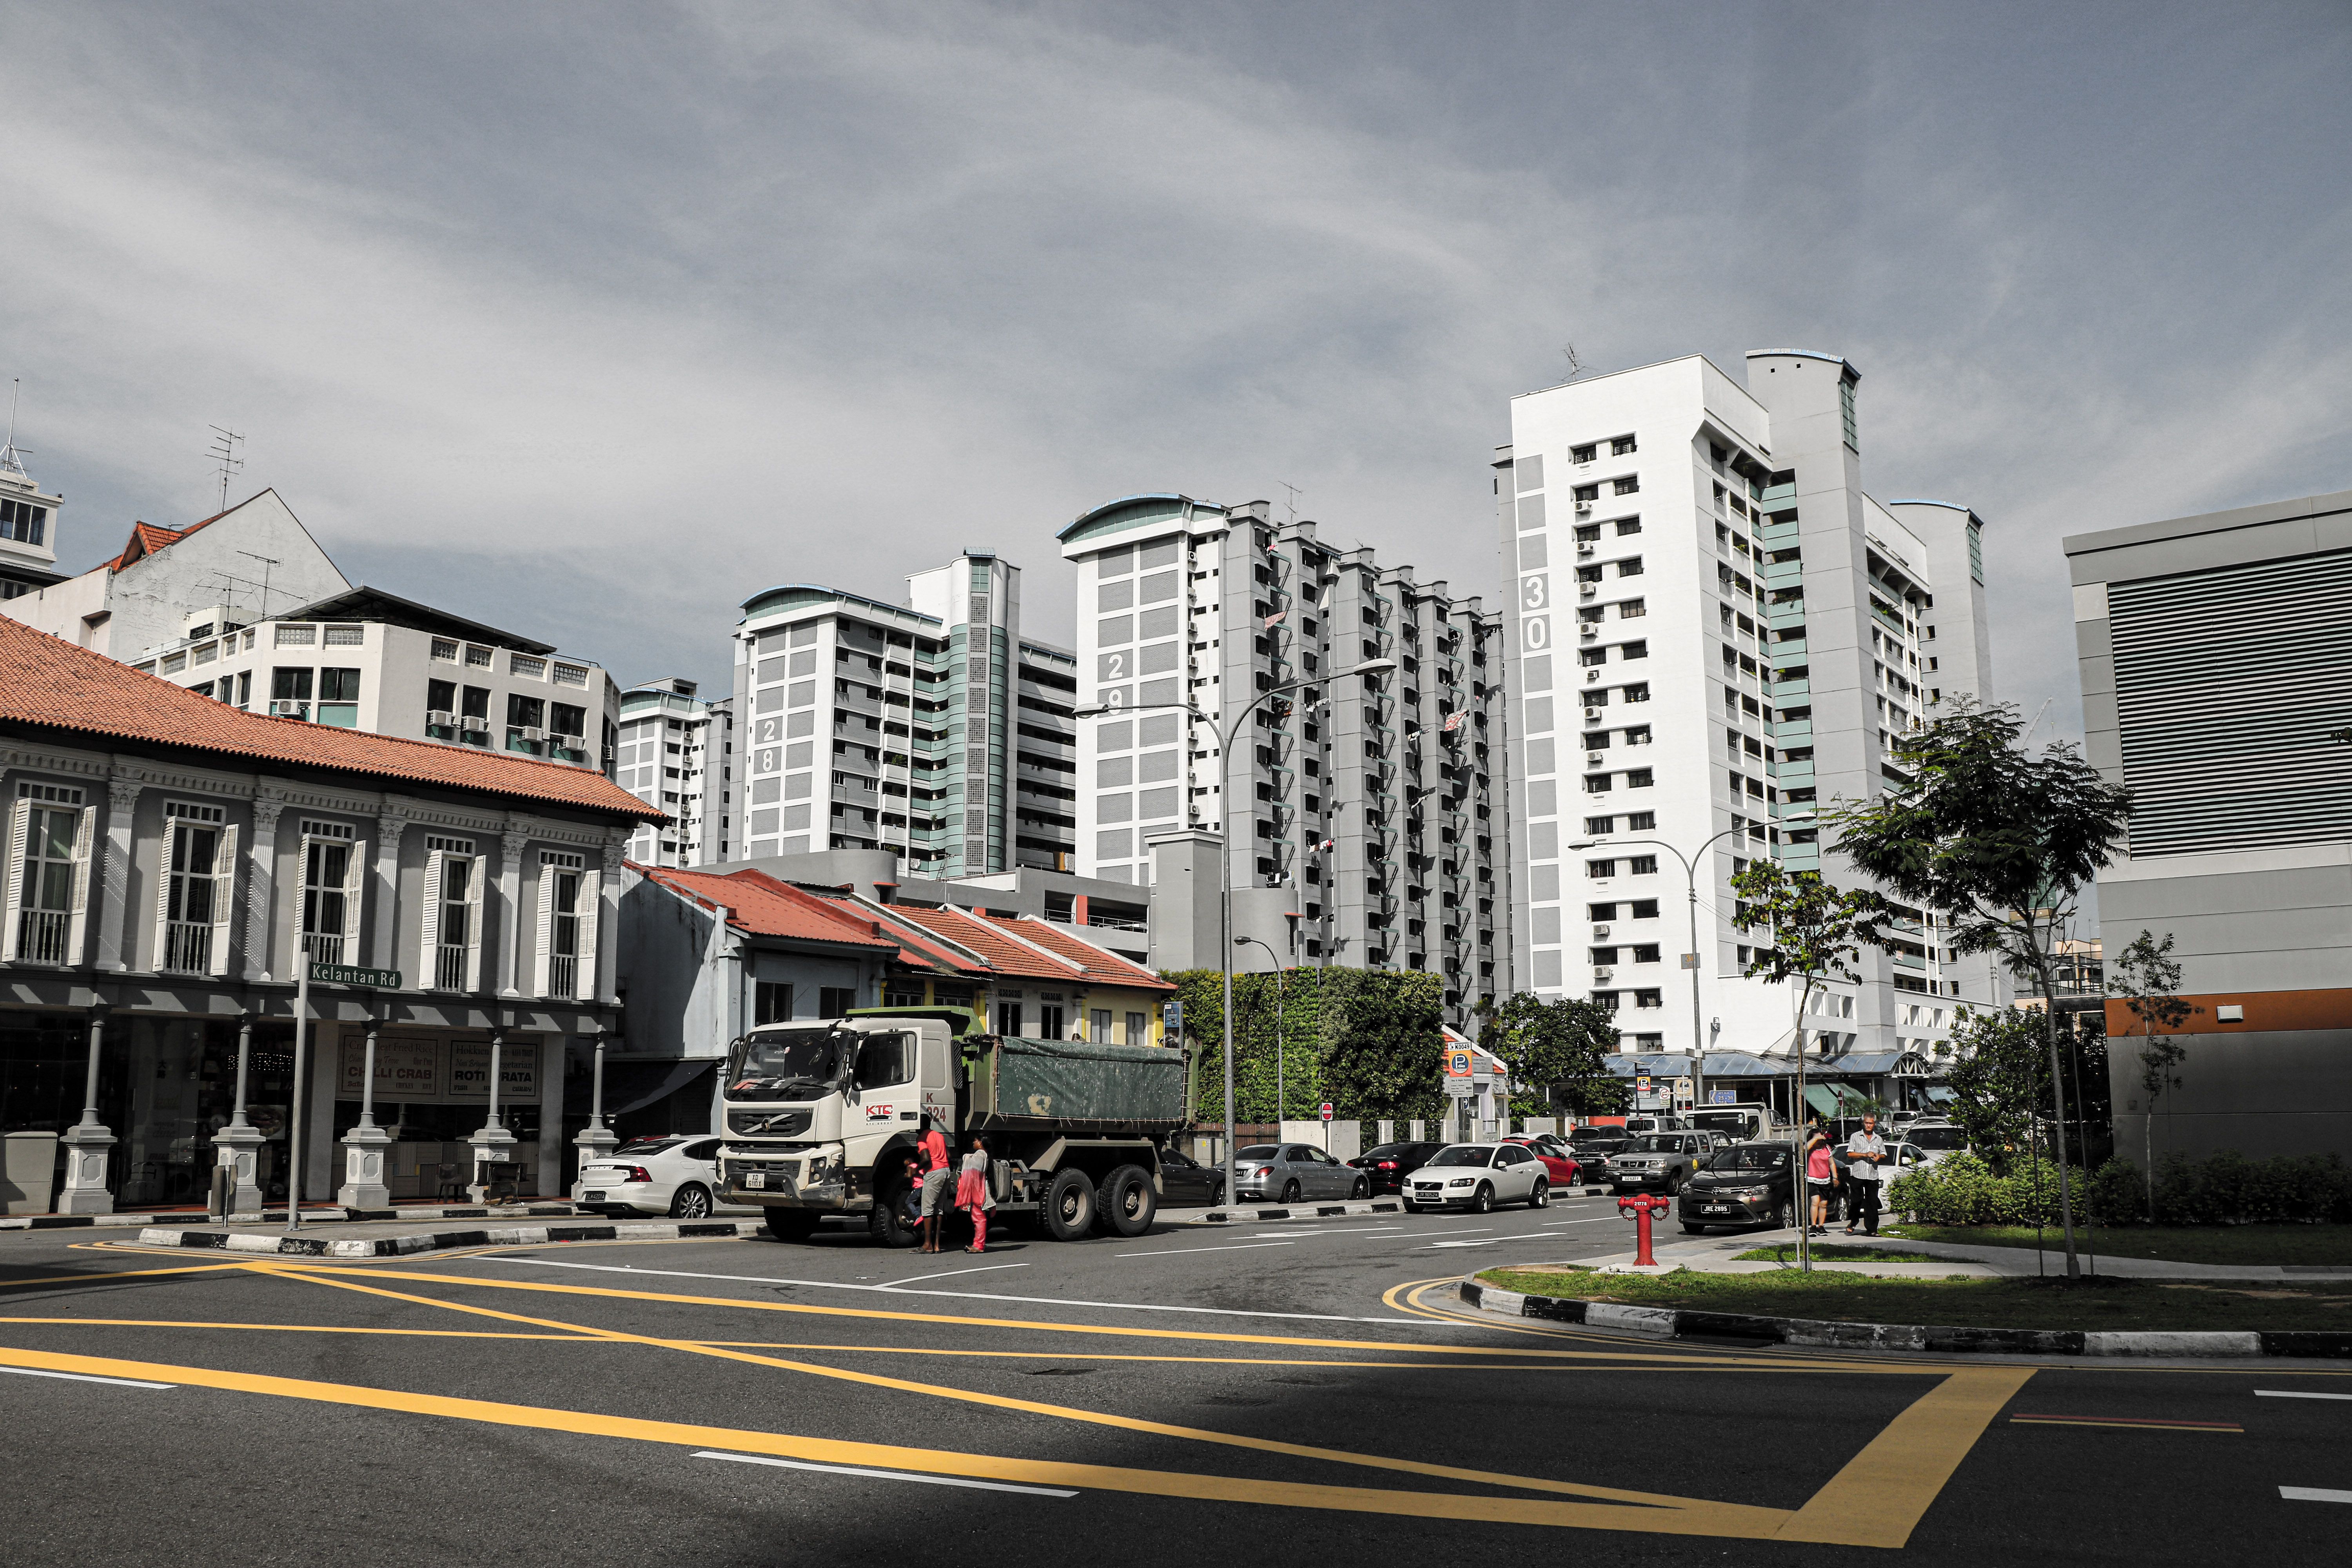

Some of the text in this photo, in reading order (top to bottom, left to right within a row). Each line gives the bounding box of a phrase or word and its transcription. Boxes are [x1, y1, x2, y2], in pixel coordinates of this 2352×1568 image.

[1526, 576, 1546, 649] 30
[1109, 654, 1123, 715] 29
[763, 720, 775, 771] 28
[312, 964, 395, 986] Kelantan Rd
[394, 1042, 413, 1052] Fried
[416, 1044, 433, 1053] Rice
[456, 1045, 490, 1055] Hokkien
[348, 1053, 364, 1062] Char
[1455, 1055, 1466, 1069] P
[499, 1060, 533, 1071] egetarian
[348, 1066, 432, 1080] CHLLI CRAB
[455, 1070, 485, 1081] ROTI
[926, 1093, 933, 1103] K
[866, 1105, 893, 1116] KTC
